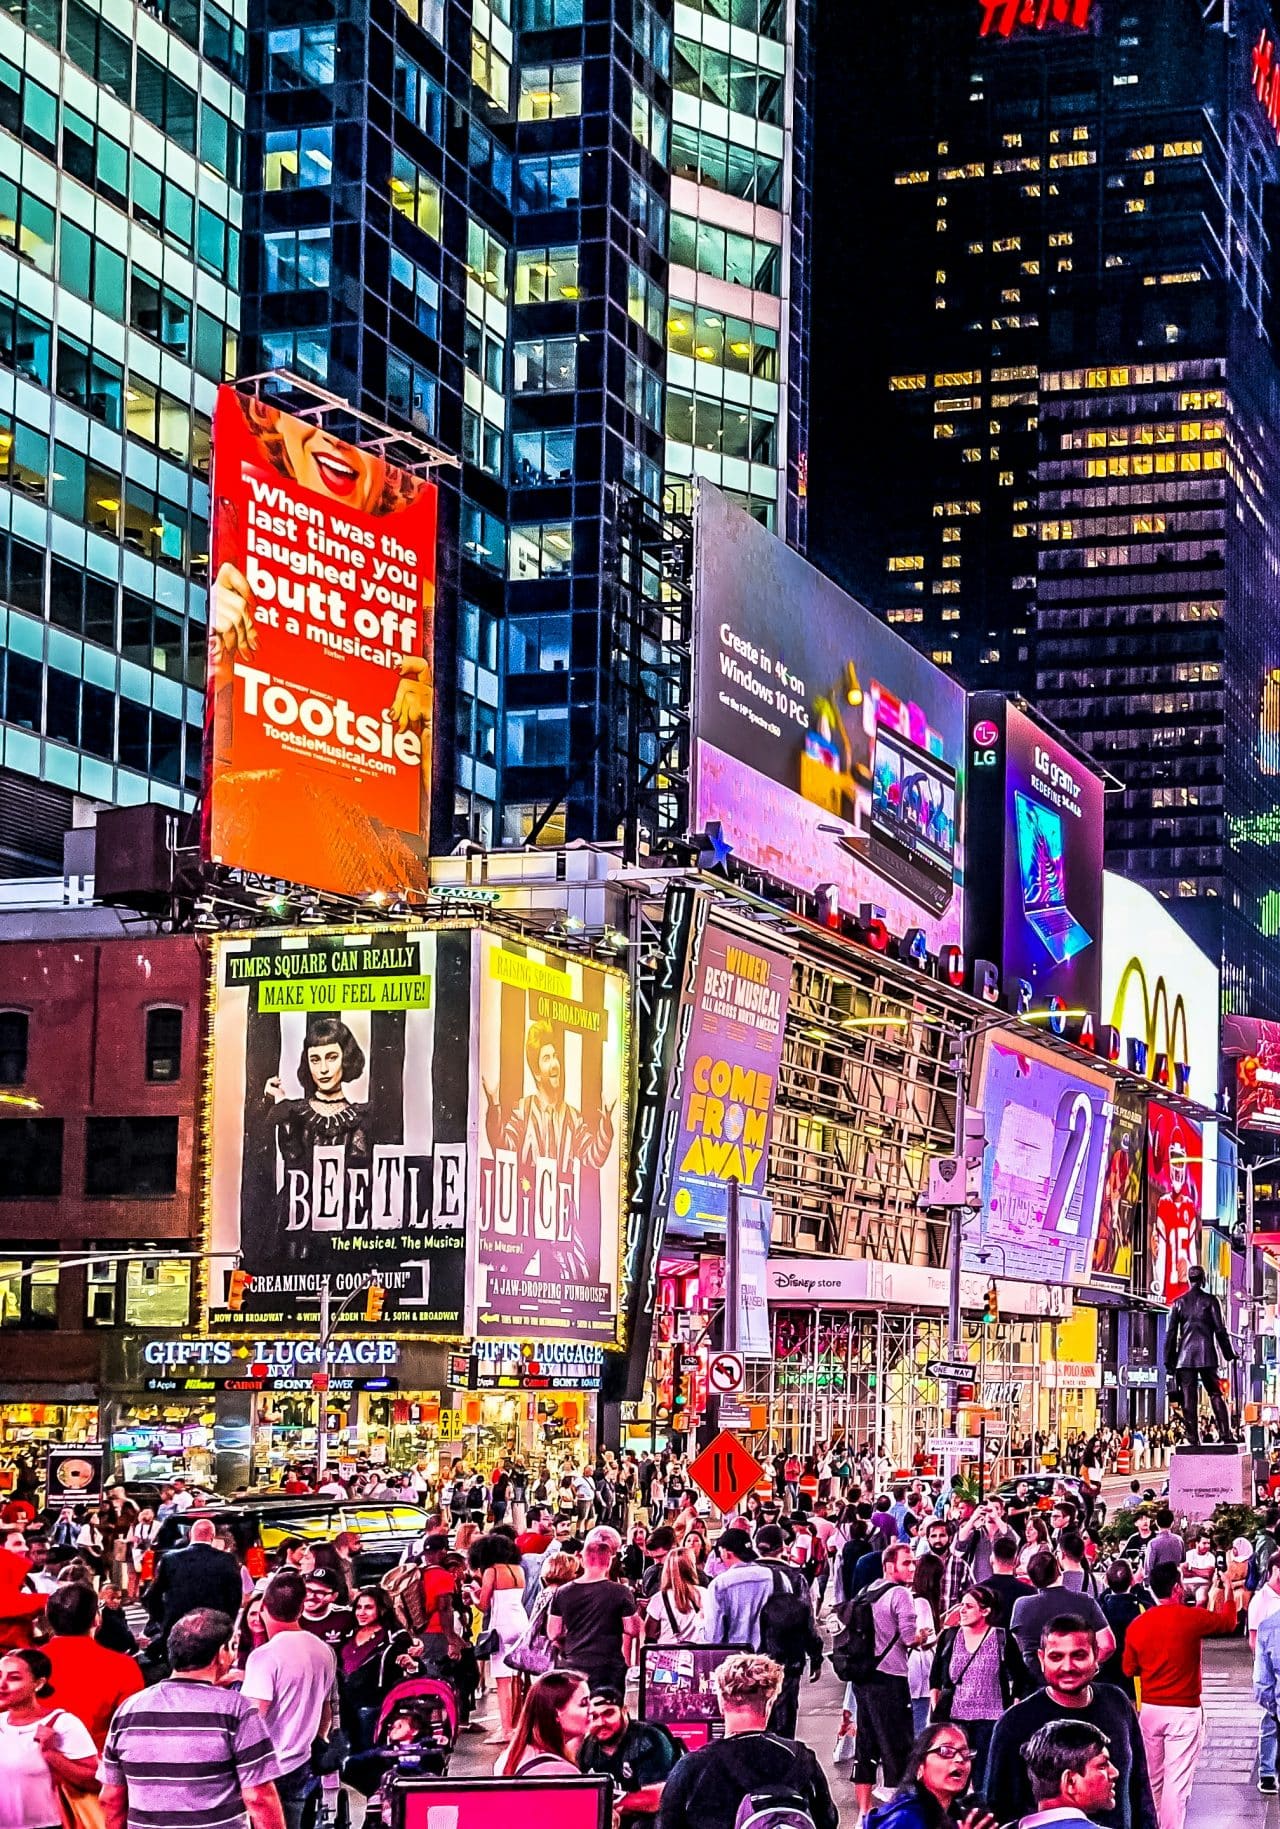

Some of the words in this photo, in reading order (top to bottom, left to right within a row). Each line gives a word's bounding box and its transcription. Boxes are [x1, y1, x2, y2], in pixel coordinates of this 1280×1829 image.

[248, 500, 298, 542] last
[306, 527, 365, 569] time
[372, 557, 417, 591] you
[330, 516, 375, 549] was
[381, 535, 418, 567] the
[247, 528, 356, 592] laughed
[360, 578, 417, 615] your
[246, 555, 347, 629] butt
[354, 608, 417, 654] off
[254, 606, 279, 629] at
[285, 616, 300, 635] a
[720, 623, 759, 665] Create
[760, 648, 772, 673] in
[789, 675, 805, 696] on
[719, 651, 774, 706] Windows
[775, 690, 788, 714] 10
[789, 699, 809, 728] PCs
[233, 662, 422, 766] Tootsie
[263, 723, 397, 775] TootsieMusical.com
[974, 751, 997, 766] LG
[1035, 746, 1050, 777] LG
[1030, 774, 1062, 808] REDEFINE
[438, 887, 495, 901] LAMAR
[229, 957, 271, 979] TIMES
[274, 953, 327, 978] SQUARE
[331, 949, 358, 972] CAN
[363, 947, 415, 970] REALLY
[497, 955, 532, 983] RAISING
[535, 969, 565, 994] SPIRITS
[264, 986, 304, 1006] MAKE
[311, 984, 336, 1004] YOU
[342, 982, 376, 1003] FEEL
[381, 981, 425, 1002] ALIVE!
[701, 995, 713, 1013] ALL
[713, 998, 738, 1021] ACROSS
[704, 966, 735, 1000] BEST
[736, 974, 782, 1020] MUSICAL
[538, 997, 551, 1017] ON
[552, 1001, 600, 1031] BROADWAY!
[693, 1054, 773, 1113] COME
[686, 1092, 768, 1147] FROM
[679, 1135, 765, 1187] AWAY
[284, 1144, 466, 1232] BEETLE
[331, 1236, 351, 1250] The
[401, 1235, 421, 1249] The
[243, 1273, 332, 1293] CREAMINGLY
[336, 1272, 371, 1291] GOOD
[500, 1278, 562, 1300] JAW-DROPPING
[817, 1279, 842, 1288] store
[145, 1341, 231, 1364] GIFTS
[253, 1341, 398, 1364] LUGGAGE
[472, 1342, 521, 1361] GIFTS
[533, 1343, 604, 1364] LUGGAGE
[224, 1379, 263, 1390] Canon
[273, 1379, 312, 1389] SONY
[552, 1378, 579, 1387] SONY
[933, 1365, 947, 1374] ONE
[953, 1368, 969, 1376] WAY
